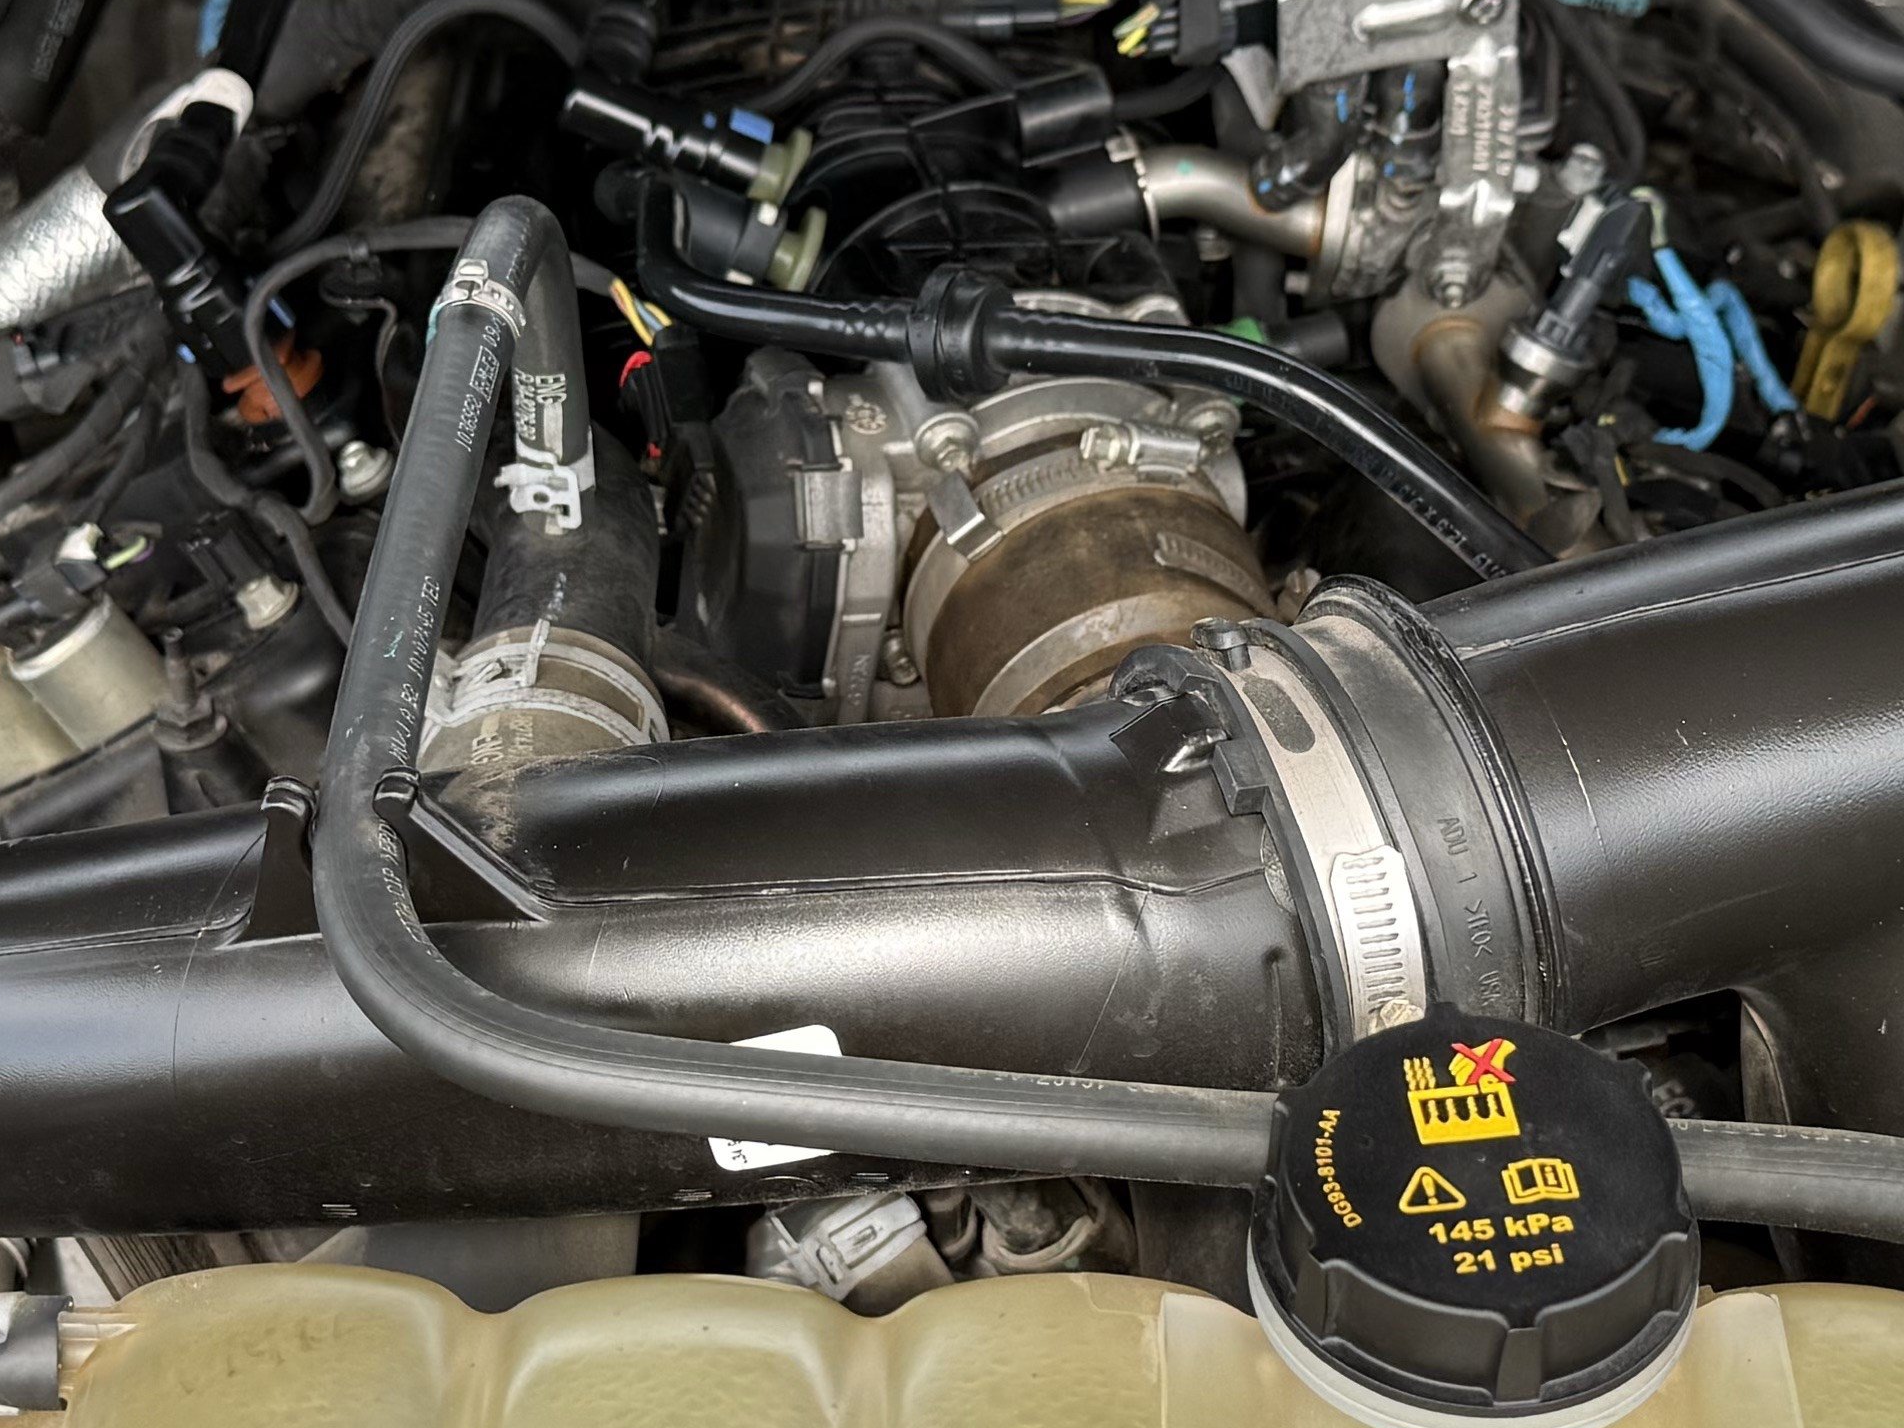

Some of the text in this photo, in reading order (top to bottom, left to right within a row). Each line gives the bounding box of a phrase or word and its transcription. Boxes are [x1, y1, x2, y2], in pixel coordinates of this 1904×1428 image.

[535, 373, 567, 405] ENG
[1428, 1212, 1575, 1244] 145 kPa
[1454, 1243, 1565, 1275] 21 psi
